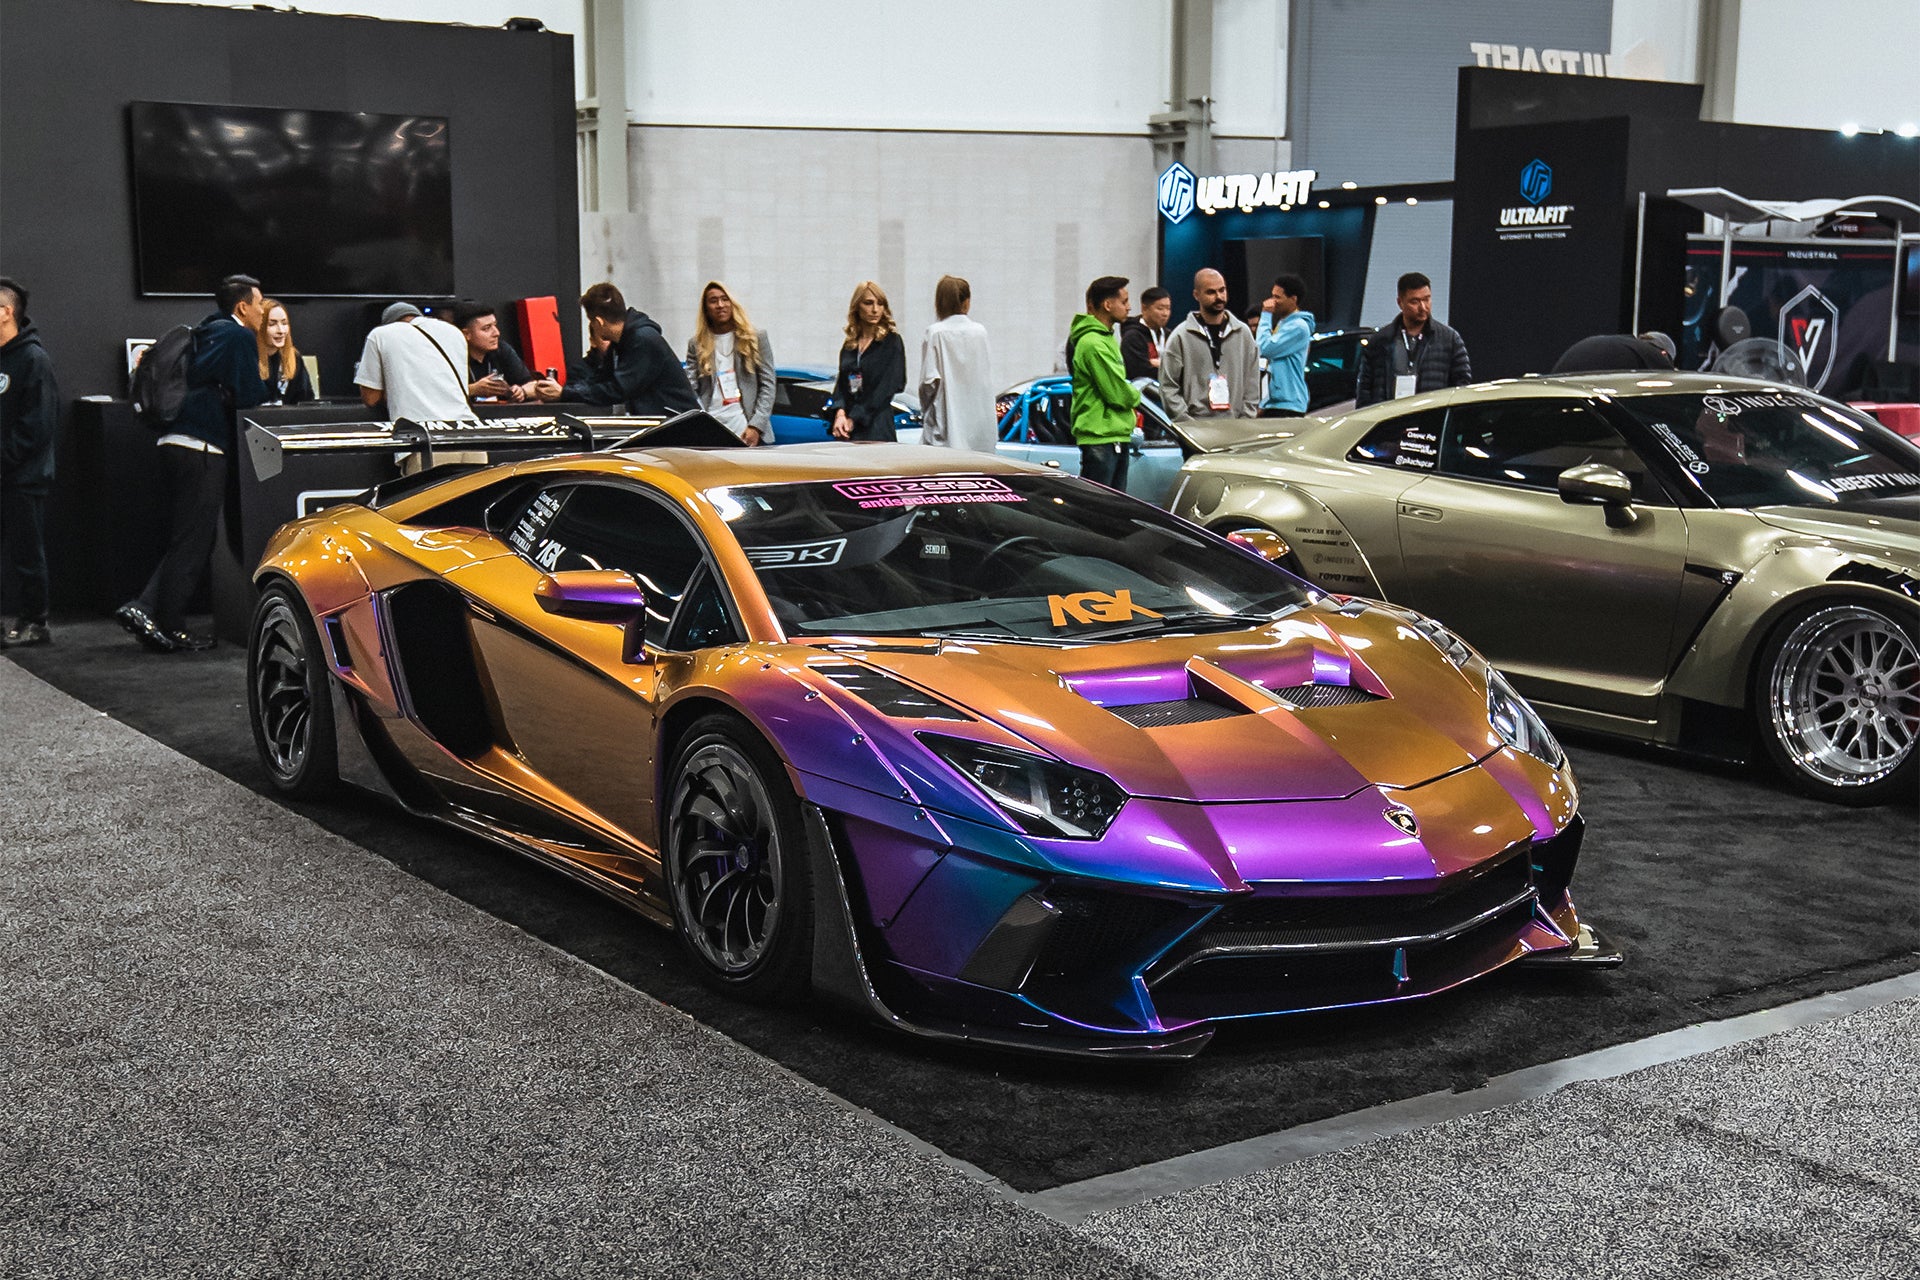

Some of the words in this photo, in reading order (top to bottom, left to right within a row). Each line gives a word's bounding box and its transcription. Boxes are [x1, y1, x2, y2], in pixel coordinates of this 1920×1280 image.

[1197, 170, 1316, 210] ULTRAFIT
[1787, 251, 1838, 259] INDUSTRIAL
[1821, 474, 1895, 493] LIBERTY
[925, 544, 941, 554] SEND
[941, 544, 947, 554] IT
